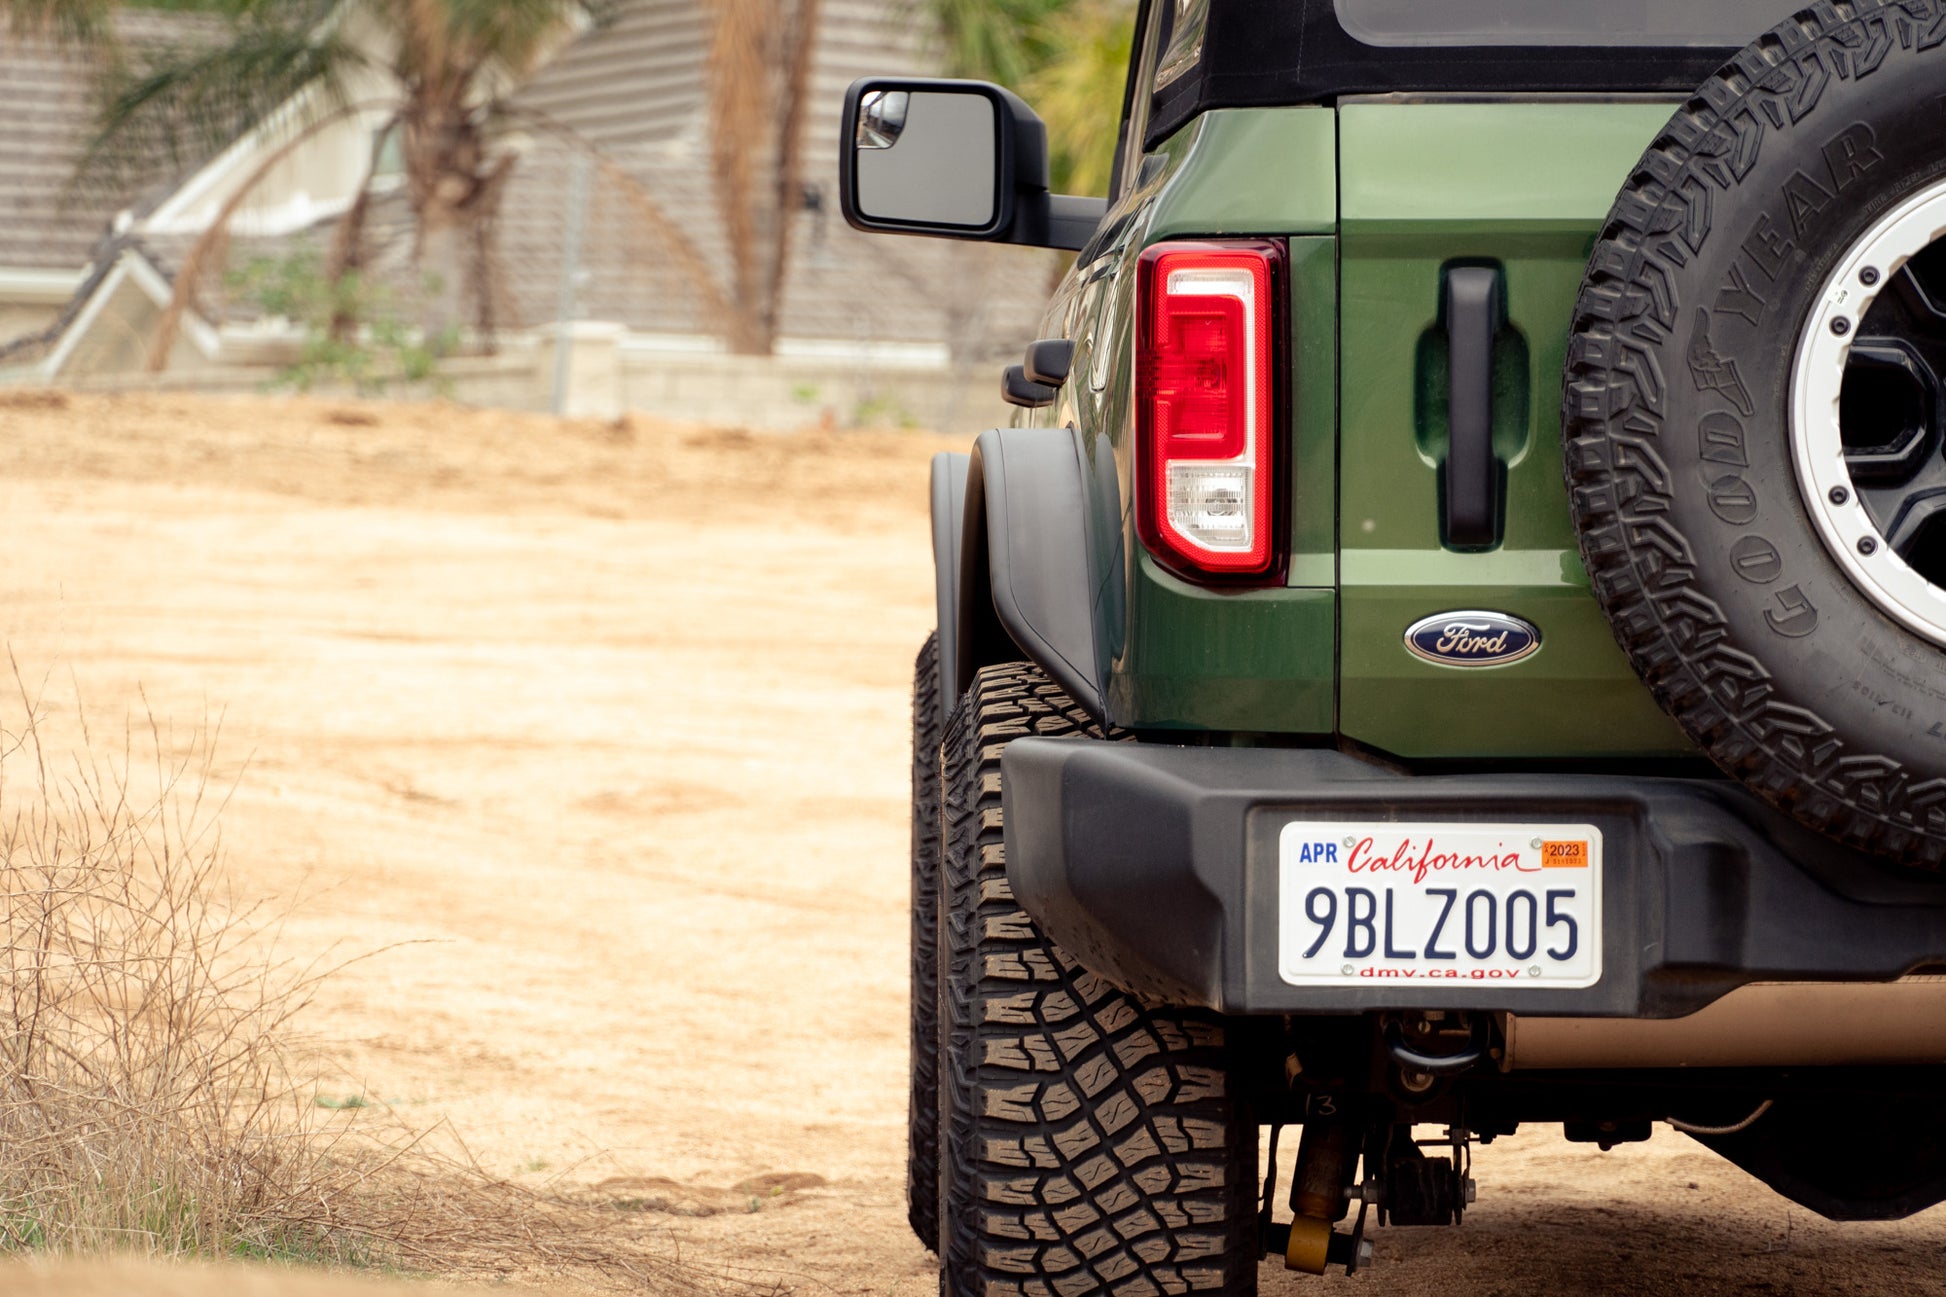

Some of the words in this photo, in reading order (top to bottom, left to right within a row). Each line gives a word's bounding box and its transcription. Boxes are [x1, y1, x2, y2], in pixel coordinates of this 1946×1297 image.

[1436, 623, 1509, 653] Ford
[1299, 843, 1338, 863] APR
[1347, 837, 1541, 884] California
[1550, 844, 1579, 856] 2023
[1302, 887, 1578, 961] 9BLZ005
[1360, 967, 1520, 979] dmv.ca.gov
